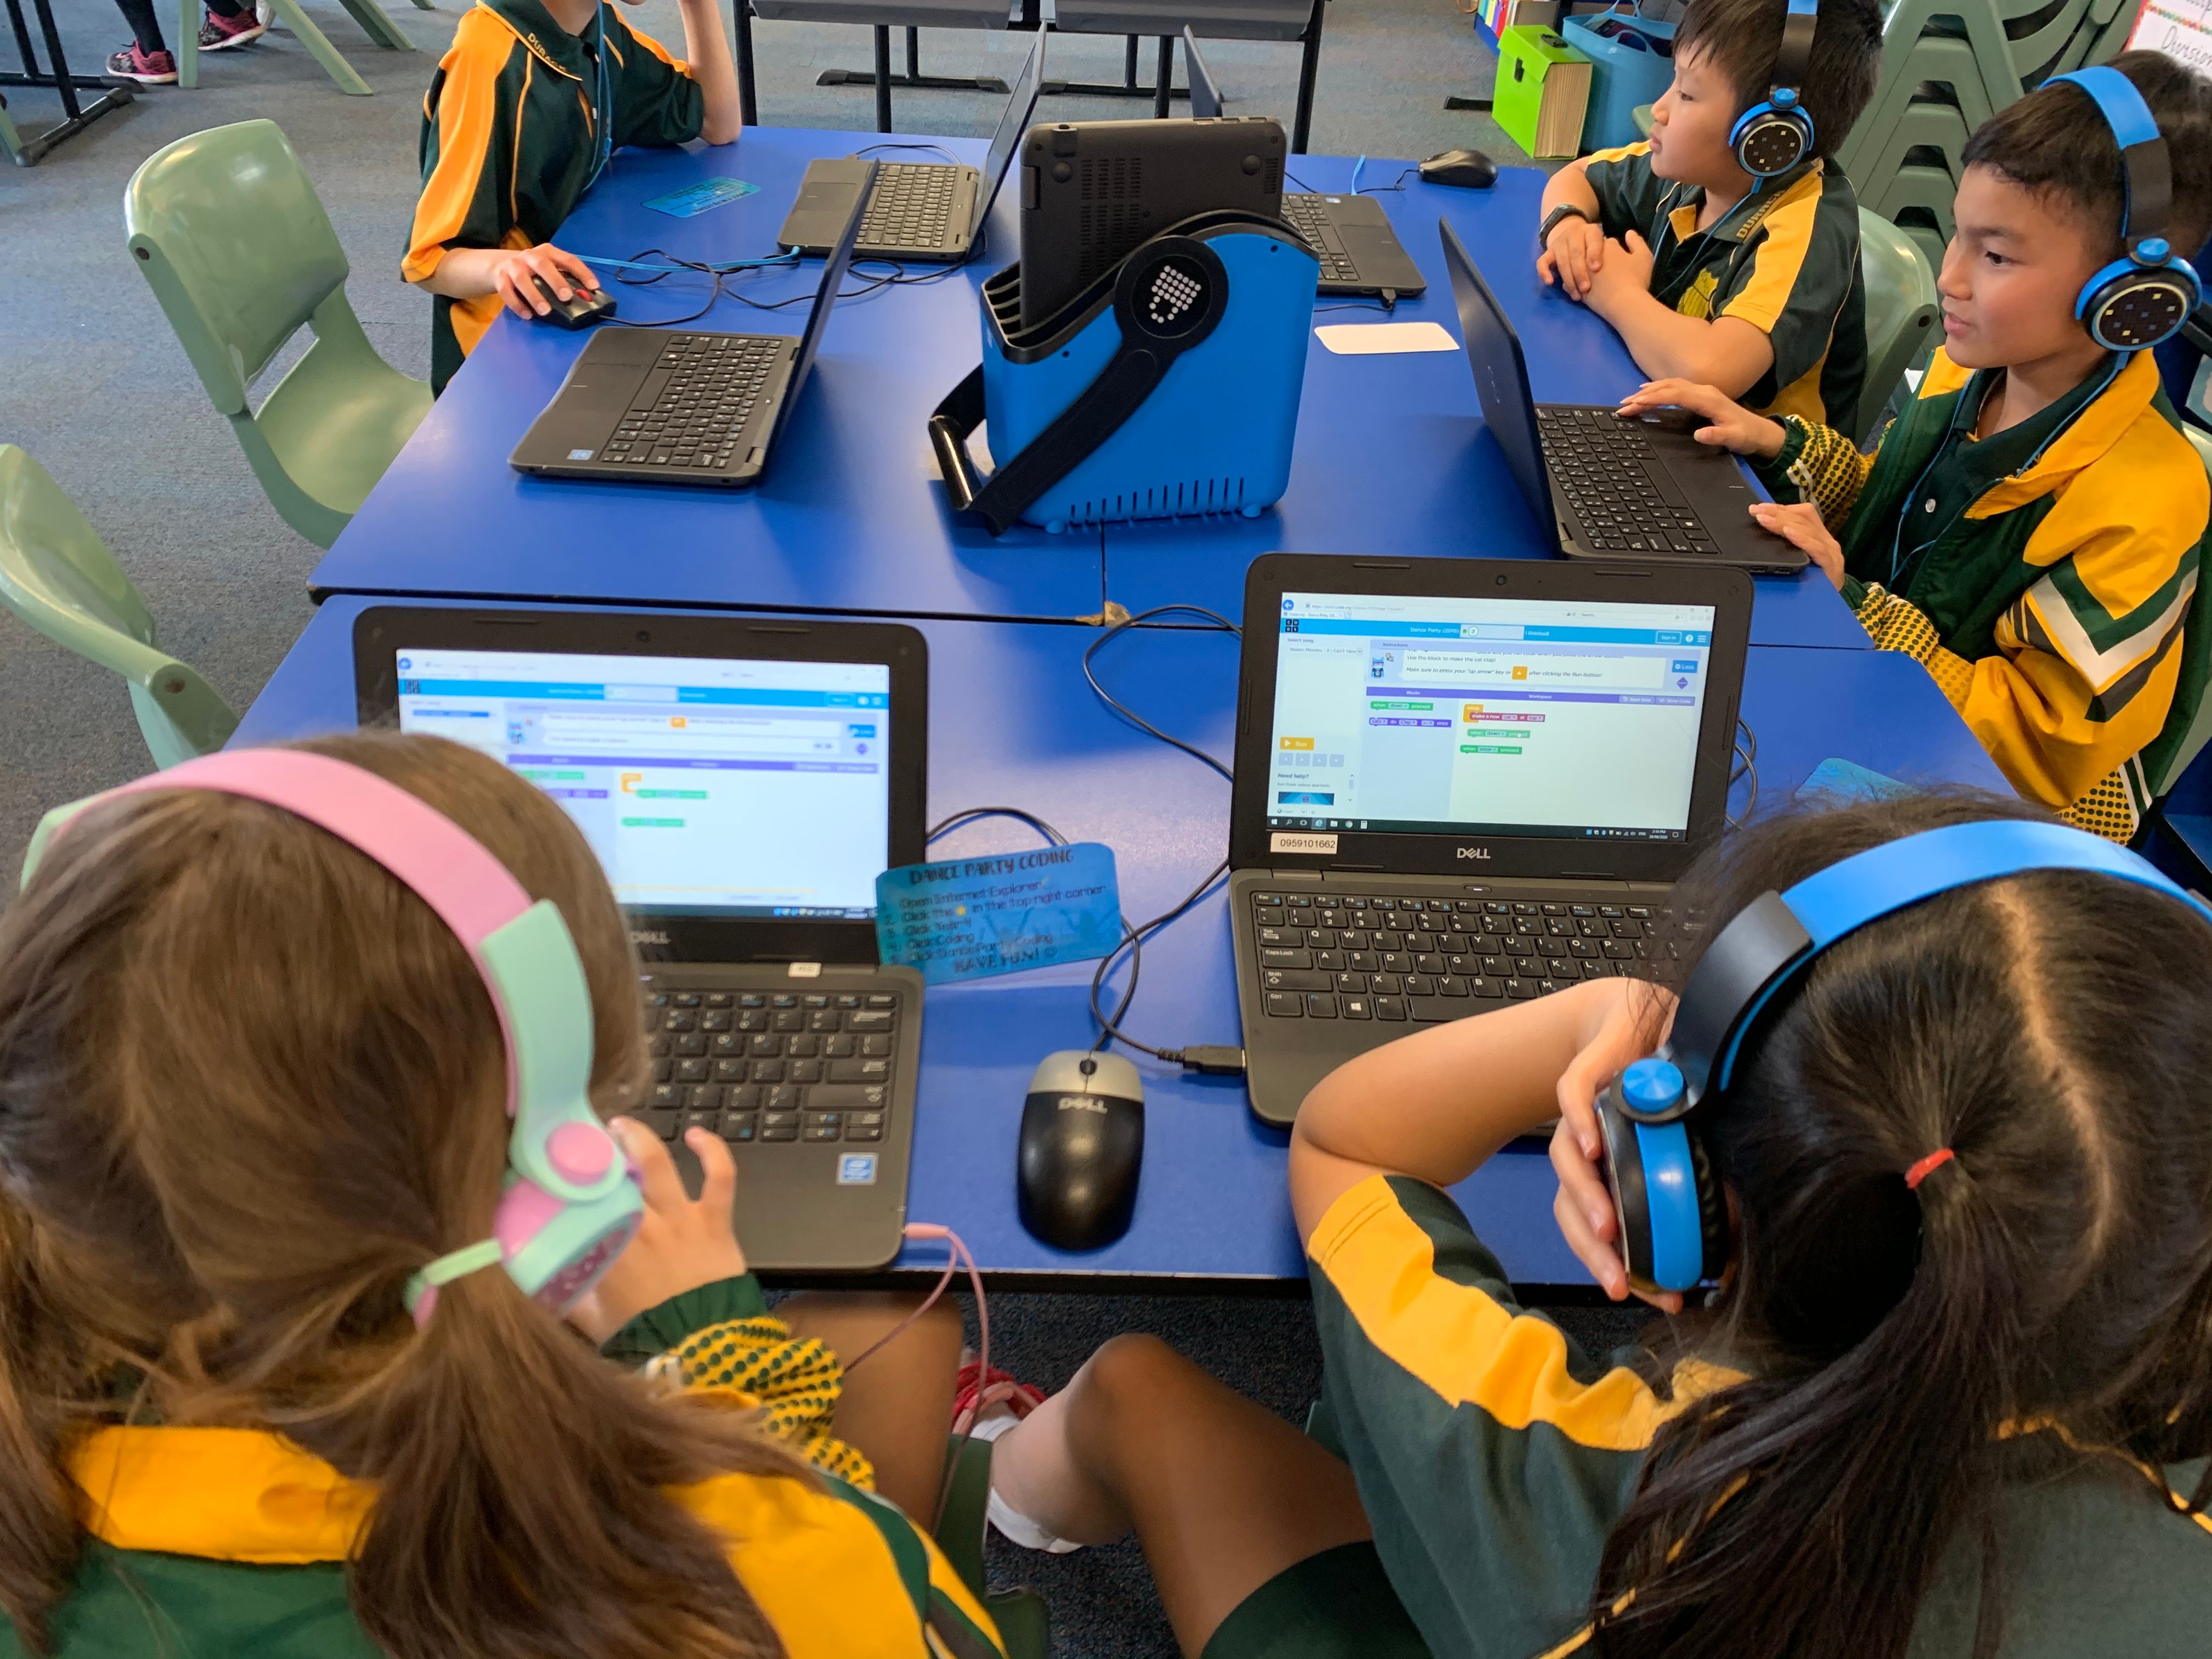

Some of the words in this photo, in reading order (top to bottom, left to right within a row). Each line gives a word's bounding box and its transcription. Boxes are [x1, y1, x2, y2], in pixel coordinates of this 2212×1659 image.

[1280, 838, 1336, 849] 0959101662
[1456, 847, 1491, 860] DELL
[911, 865, 959, 885] DANCE
[964, 857, 1015, 878] PARTY
[1019, 849, 1074, 871] CODING
[900, 896, 933, 909] Open
[934, 890, 986, 904] Internet
[989, 881, 1041, 898] Explorer
[903, 911, 930, 923] Click
[985, 899, 1007, 911] the
[1009, 895, 1032, 909] top
[1033, 889, 1062, 905] right
[1065, 884, 1107, 899] corner
[935, 932, 975, 946] Coding
[1311, 930, 1319, 938] Q
[936, 945, 974, 958] Dance
[1015, 933, 1054, 947] Coding
[954, 953, 998, 973] HAVE
[1058, 1097, 1108, 1114] DELL
